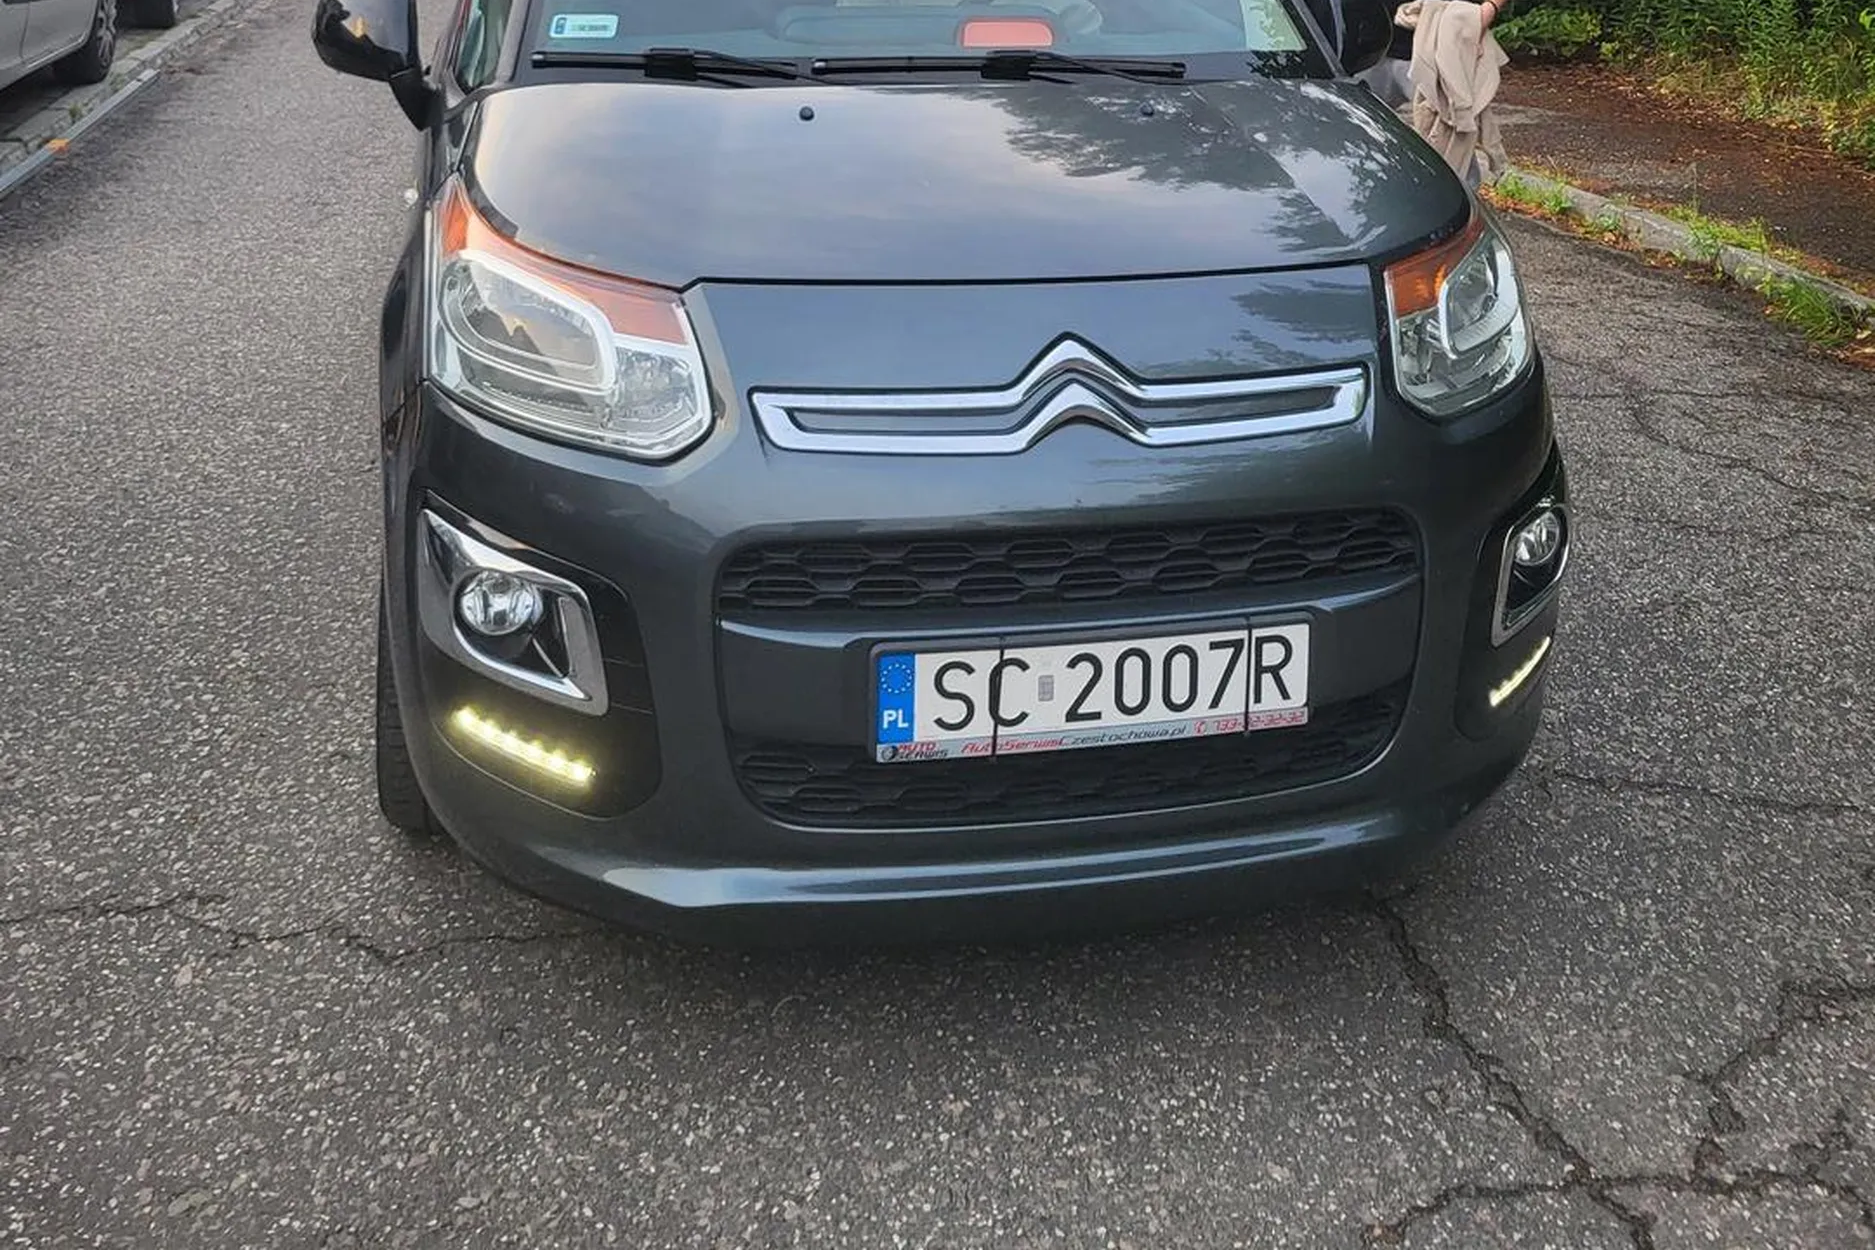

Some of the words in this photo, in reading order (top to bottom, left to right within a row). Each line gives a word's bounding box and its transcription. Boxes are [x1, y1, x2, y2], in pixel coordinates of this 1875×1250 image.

[932, 657, 1031, 732] SC
[1064, 634, 1294, 724] 2007R
[882, 707, 909, 729] PL
